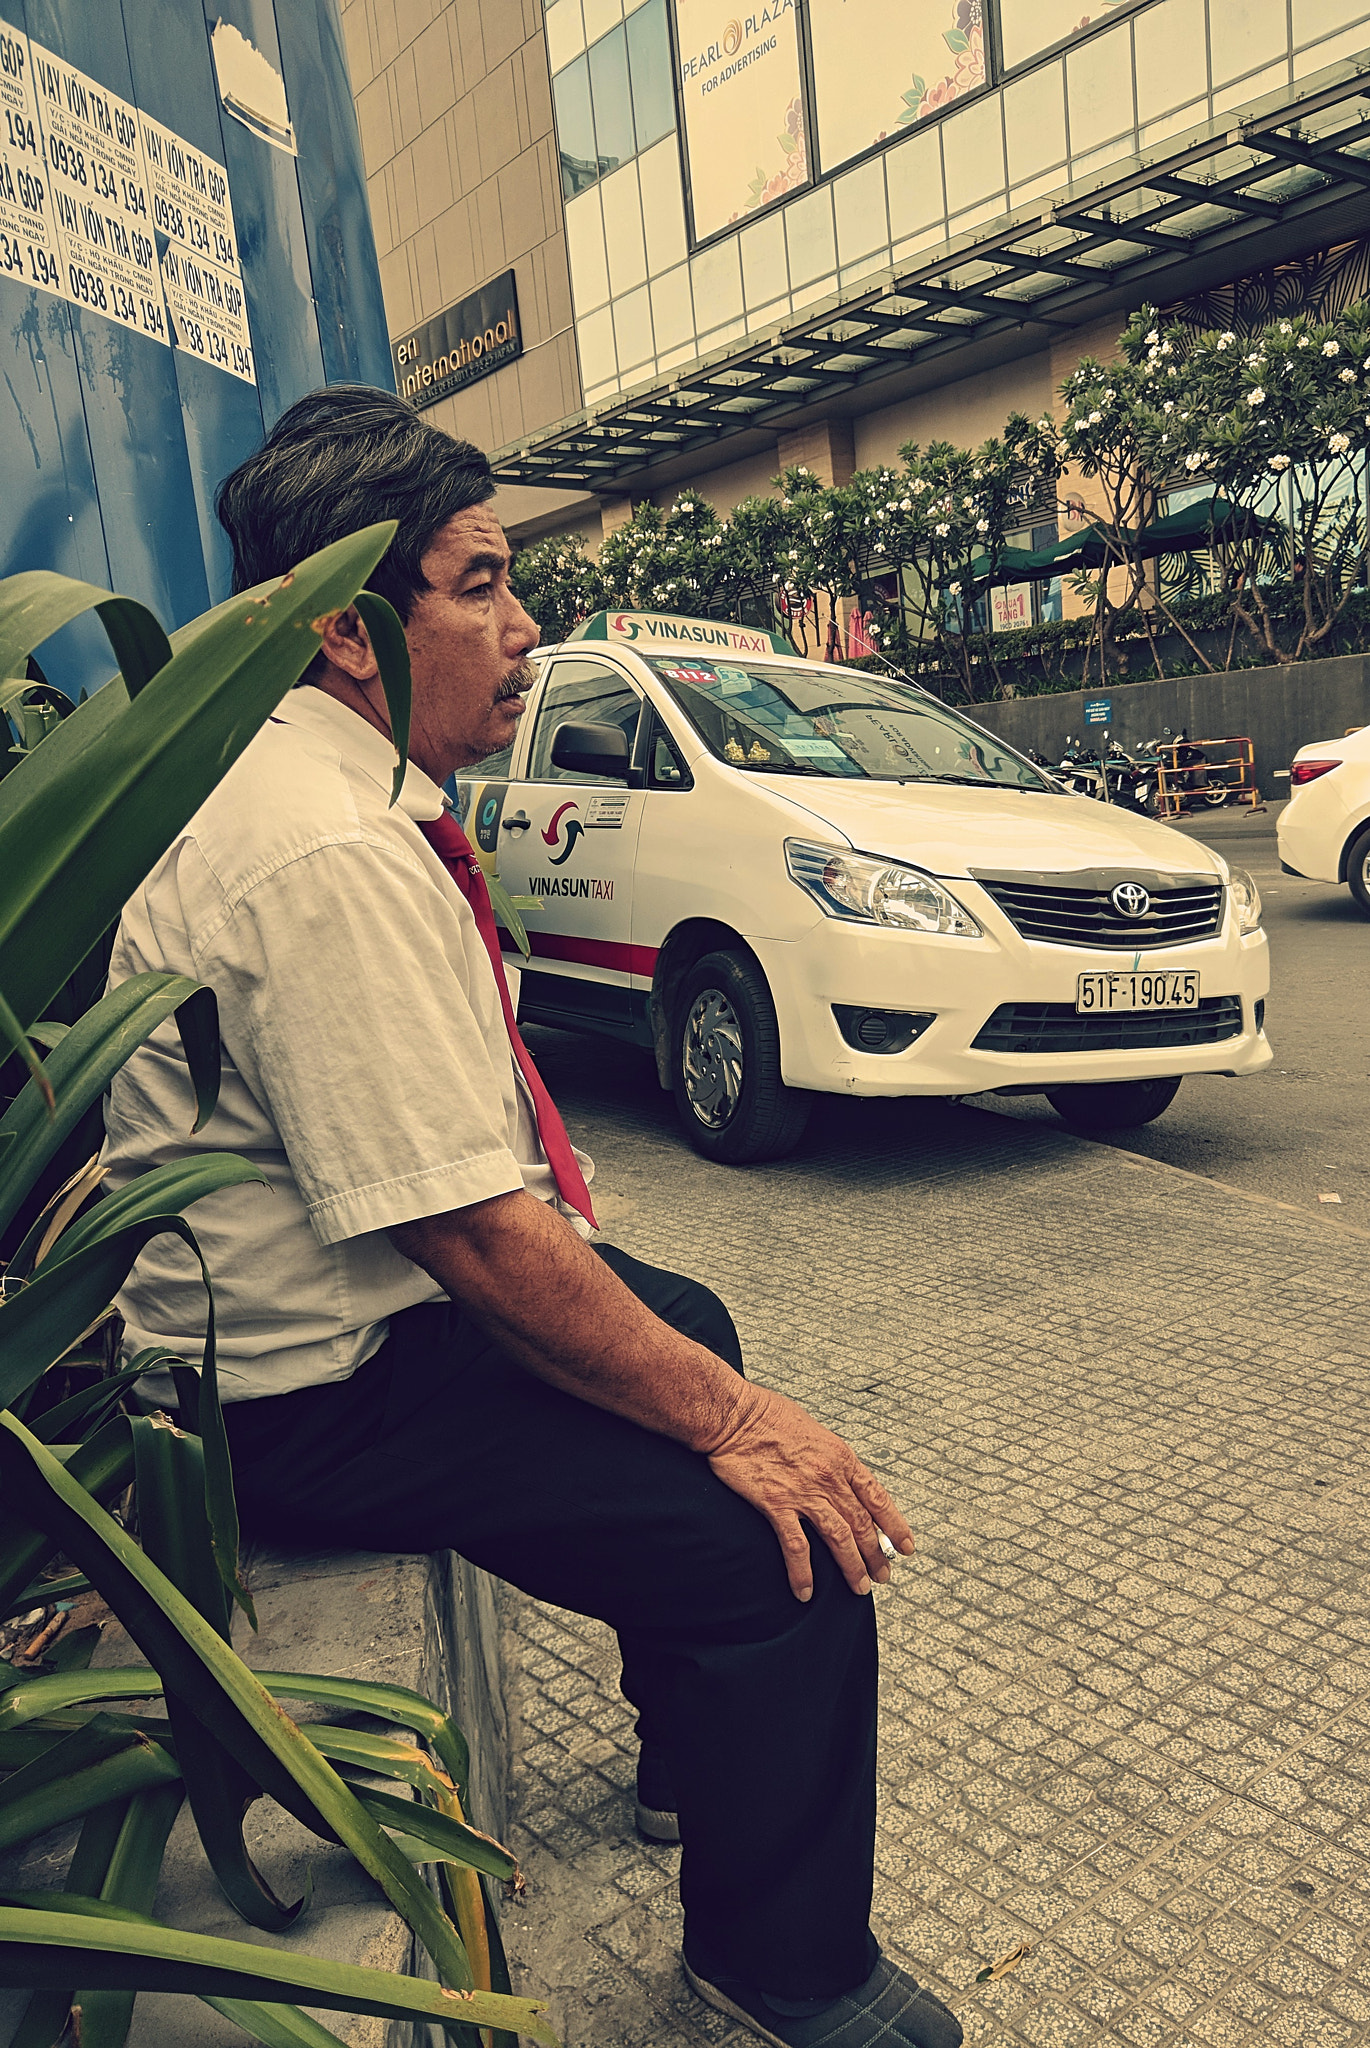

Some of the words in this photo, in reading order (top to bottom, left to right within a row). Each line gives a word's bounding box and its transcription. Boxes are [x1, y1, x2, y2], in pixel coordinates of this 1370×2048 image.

[0, 31, 24, 81] GÓP
[683, 41, 723, 83] PEARL
[745, 0, 793, 39] PLAZA
[701, 76, 719, 96] FOR
[720, 35, 777, 84] ADVERTISING
[36, 57, 62, 105] VAY
[63, 73, 90, 124] VỐN
[89, 92, 114, 139] TRẢ
[114, 106, 136, 152] GÓP
[5, 109, 36, 156] 194
[91, 145, 116, 166] TRONG
[114, 148, 135, 167] CMND
[17, 165, 44, 215] GÓP
[50, 135, 87, 187] 0938
[91, 160, 117, 204] 134
[121, 178, 147, 220] 194
[143, 124, 163, 168] VAY
[164, 138, 187, 183] VỐN
[186, 154, 207, 197] TRẢ
[208, 166, 226, 208] GÓP
[19, 214, 44, 231] CMND
[54, 188, 79, 234] VAY
[79, 201, 107, 249] VỐN
[105, 216, 132, 261] TRẢ
[131, 228, 153, 272] GÓP
[154, 194, 185, 239] 0938
[187, 215, 210, 254] 134
[213, 231, 235, 269] 194
[188, 203, 209, 220] TRONG
[208, 205, 225, 221] CMND
[0, 235, 24, 275] 34
[27, 245, 60, 289] 194
[110, 269, 135, 288] TRONG
[132, 271, 153, 286] CMND
[165, 250, 181, 286] VAY
[181, 255, 204, 300] VỐN
[203, 269, 224, 309] TRẢ
[224, 279, 241, 318] GÓP
[69, 264, 108, 311] 0938
[110, 283, 137, 325] 134
[140, 297, 164, 338] 194
[206, 316, 226, 333] TRONG
[206, 329, 228, 366] 134
[231, 342, 251, 378] 194
[402, 309, 517, 399] international
[665, 669, 716, 682] 8112
[1082, 974, 1196, 1009] 51F-190.45
